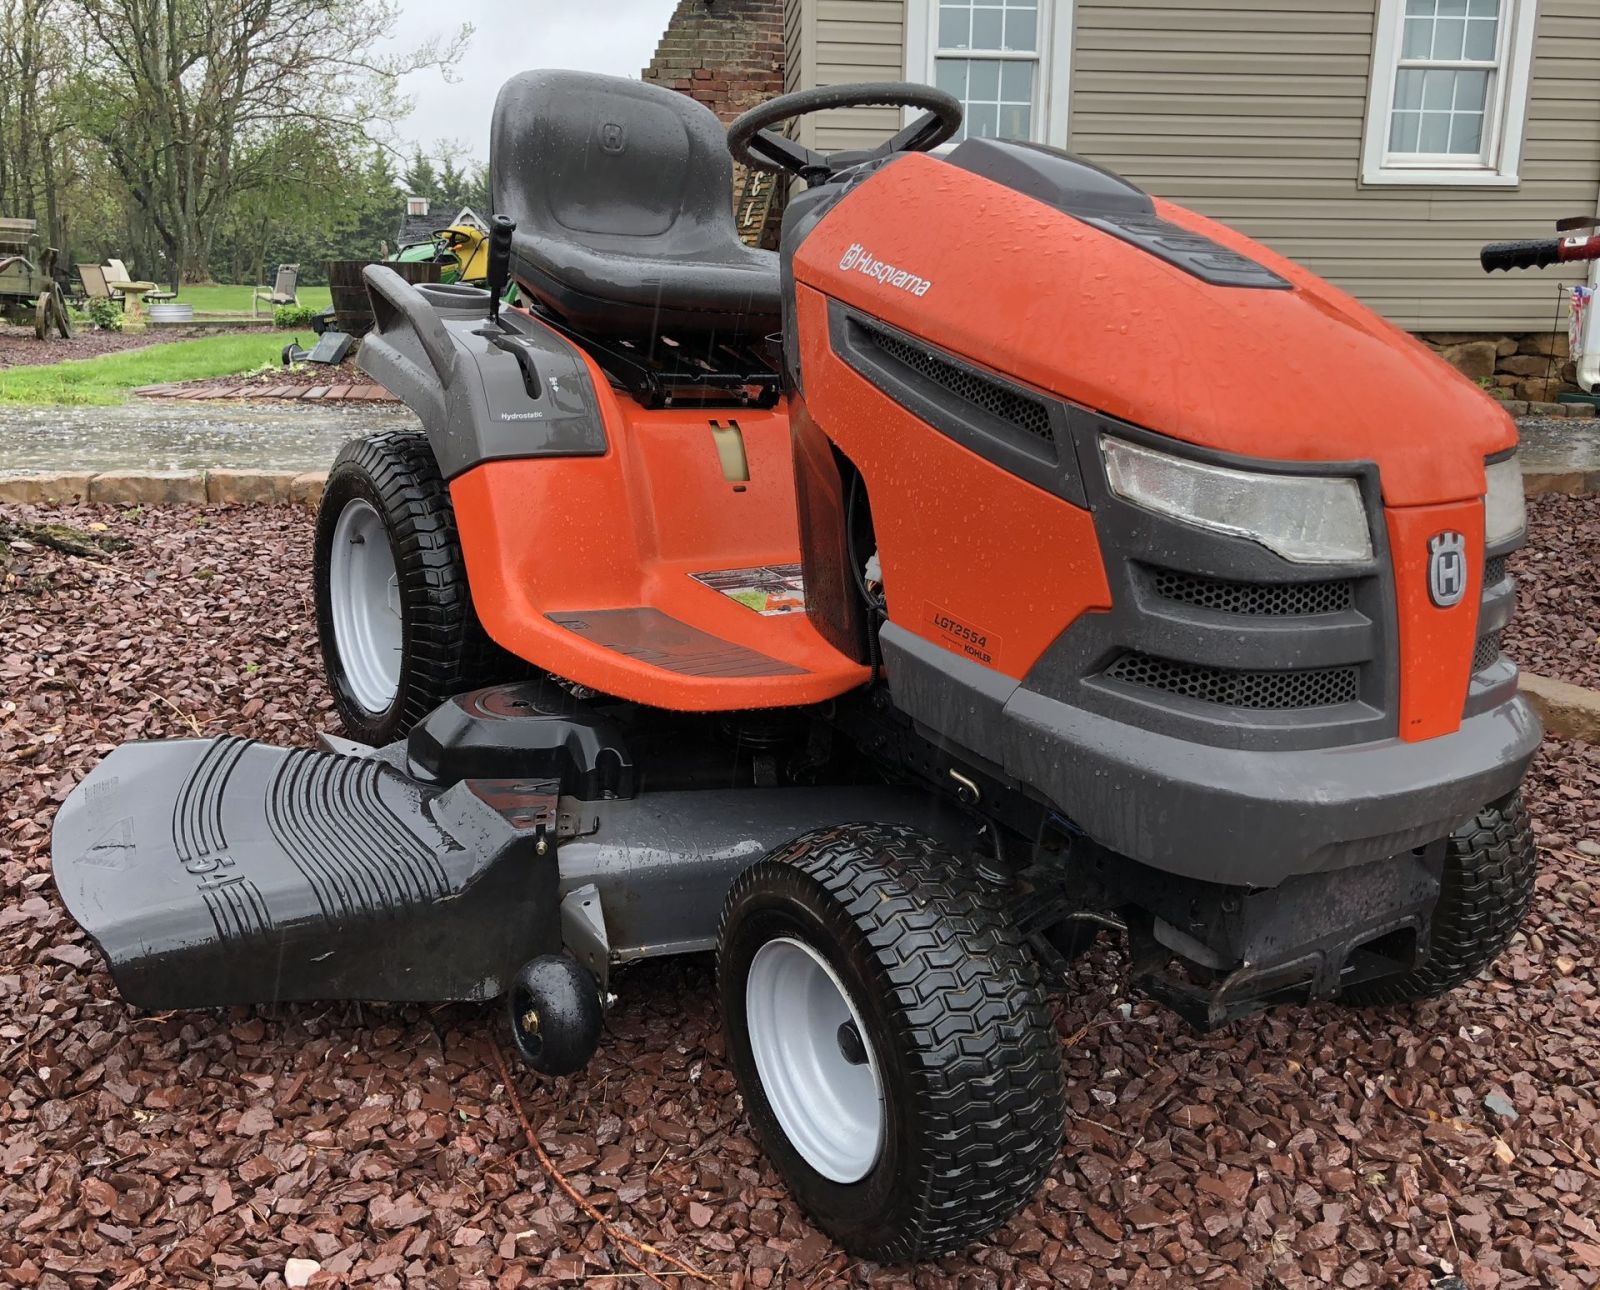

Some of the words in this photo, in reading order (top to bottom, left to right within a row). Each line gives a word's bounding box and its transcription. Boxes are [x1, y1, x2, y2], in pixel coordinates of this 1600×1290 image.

[853, 251, 931, 296] Husqvarna
[501, 411, 542, 420] Hydrostatic
[934, 613, 987, 648] LGT2554
[964, 644, 992, 664] KOHLER
